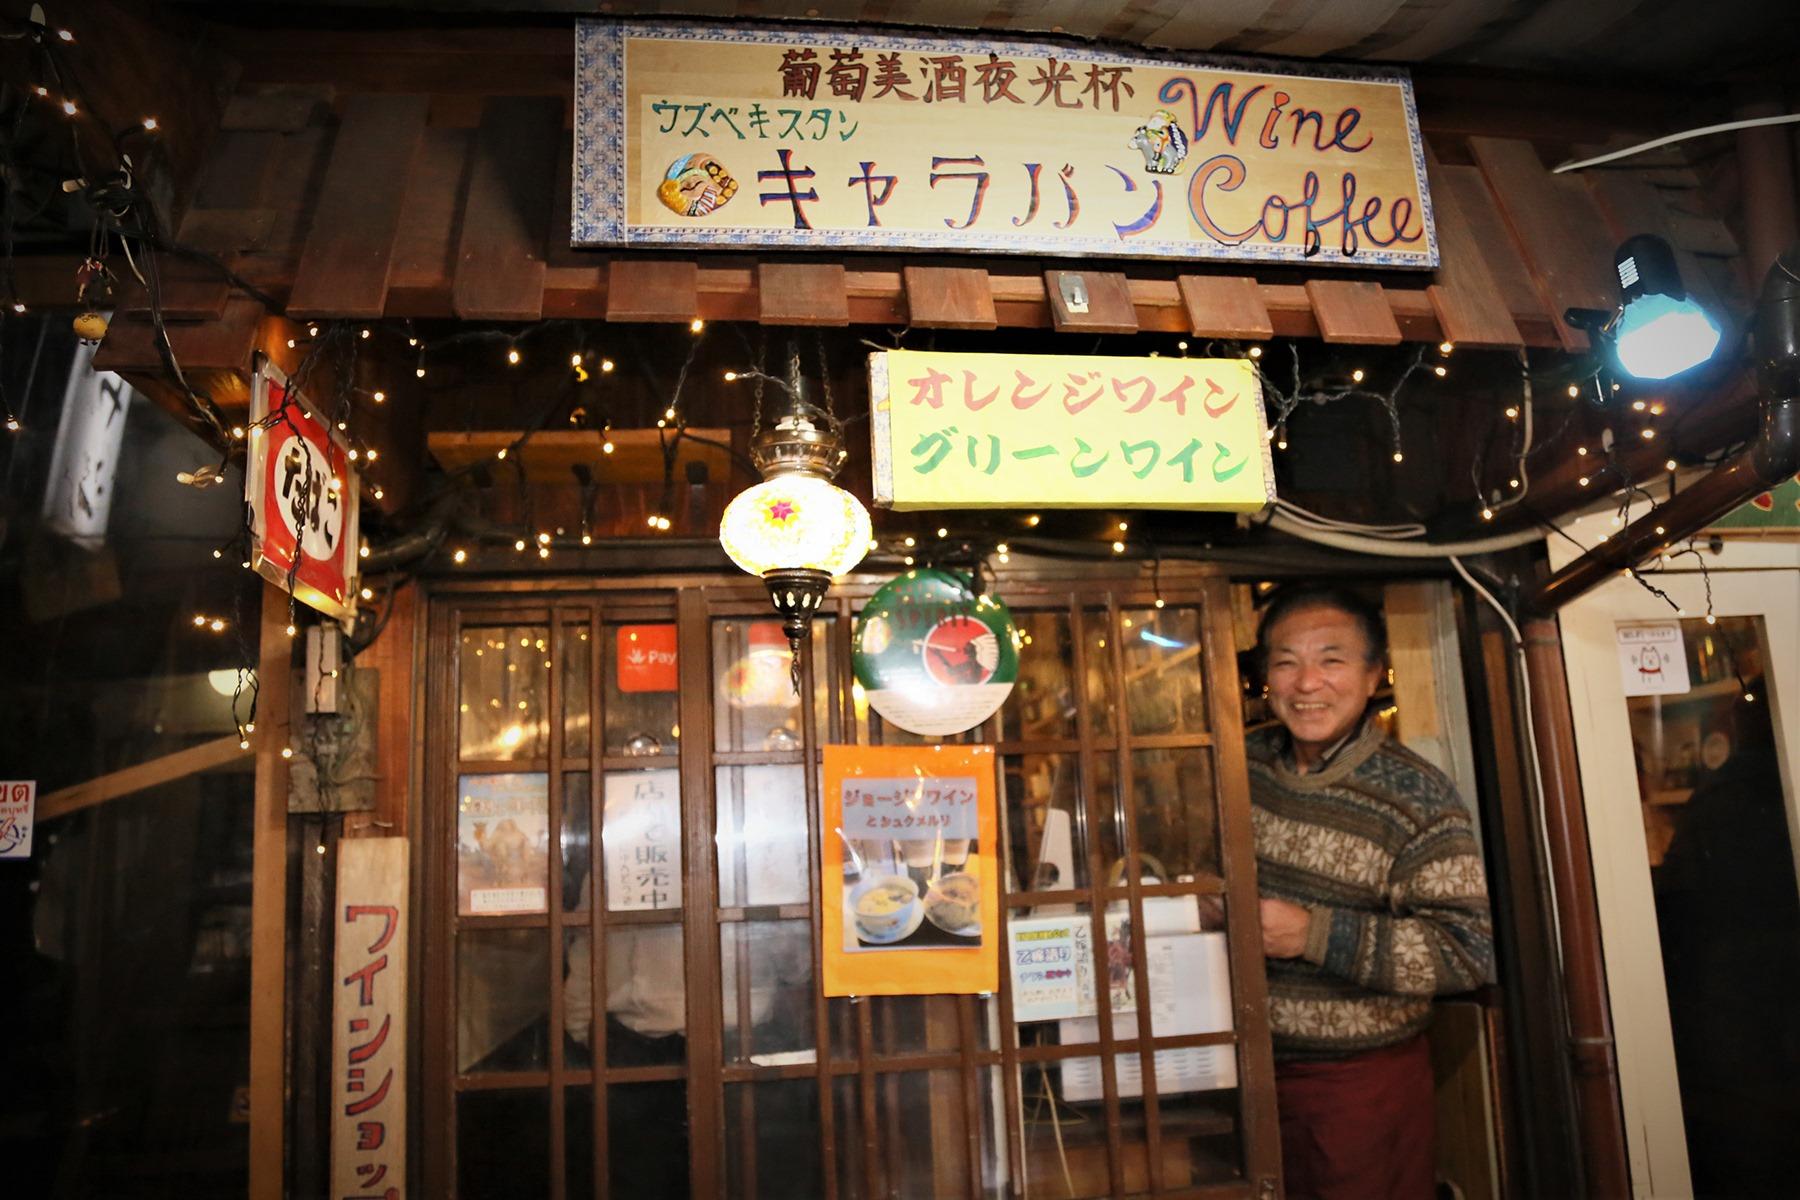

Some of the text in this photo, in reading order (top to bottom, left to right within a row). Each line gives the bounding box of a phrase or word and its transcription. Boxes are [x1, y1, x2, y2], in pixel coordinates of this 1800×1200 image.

[777, 47, 1134, 112] 葡萄美酒夜光杯
[652, 103, 859, 142] ウズベキスタン
[1158, 77, 1373, 153] Wine
[757, 149, 1163, 240] キャラバン
[1188, 154, 1423, 257] Coffee
[908, 366, 1240, 418] オレンジワイン
[910, 426, 1249, 483] グリーンワイン
[843, 788, 974, 808] ジョージワイン
